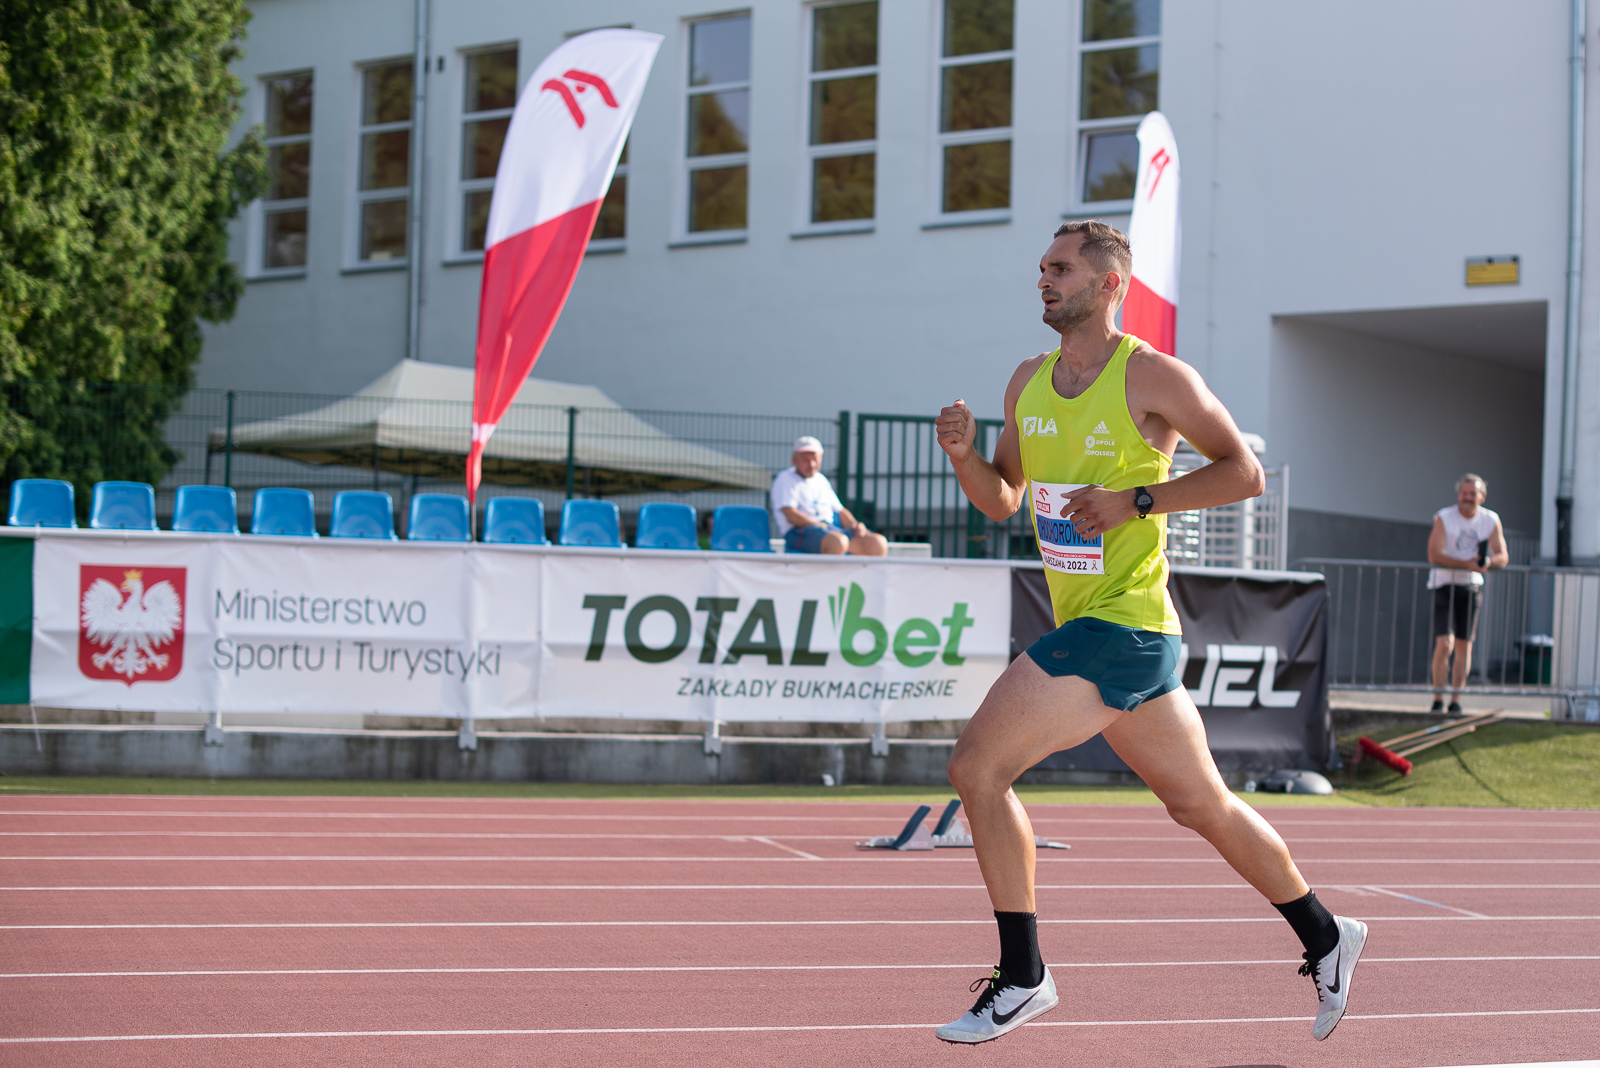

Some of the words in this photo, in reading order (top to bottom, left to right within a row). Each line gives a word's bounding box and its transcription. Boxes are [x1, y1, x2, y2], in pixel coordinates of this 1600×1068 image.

[1066, 560, 1088, 571] 2022
[215, 588, 427, 626] Ministerstwo
[582, 581, 975, 668] TOTALbet
[213, 637, 325, 678] Sportu
[335, 640, 342, 671] i
[352, 640, 502, 683] Turystyki
[1177, 643, 1301, 709] UEL
[677, 677, 778, 698] ZAKŁADY
[782, 679, 958, 701] BUKMACHERSKIE
